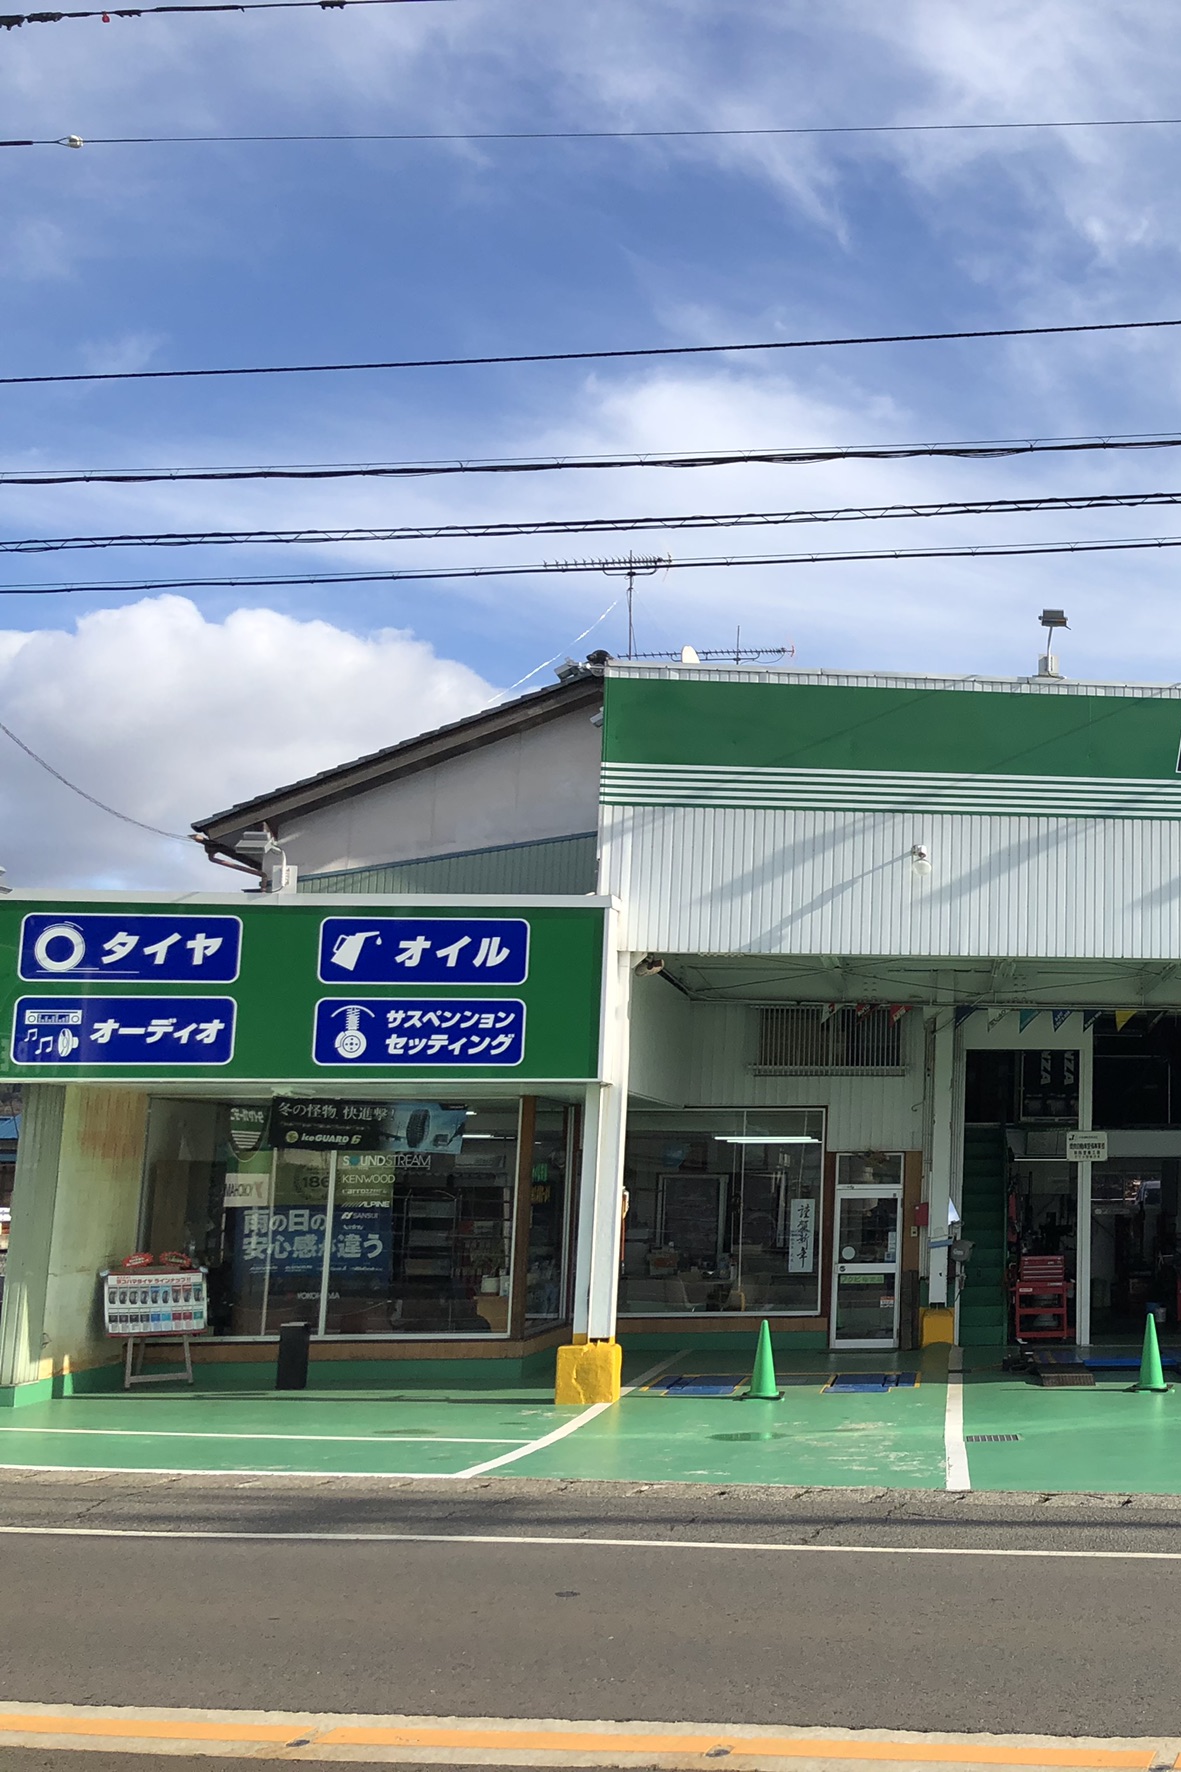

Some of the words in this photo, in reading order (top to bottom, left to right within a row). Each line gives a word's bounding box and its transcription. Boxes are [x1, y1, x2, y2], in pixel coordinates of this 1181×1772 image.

[101, 931, 223, 966] タイヤ
[394, 935, 511, 969] オイル
[89, 1018, 226, 1044] オーディオ
[385, 1033, 516, 1056] セッティング
[342, 1174, 396, 1184] KENWOOD
[243, 1210, 326, 1234] 雨の日の
[297, 1292, 340, 1300] YOKOHMA
